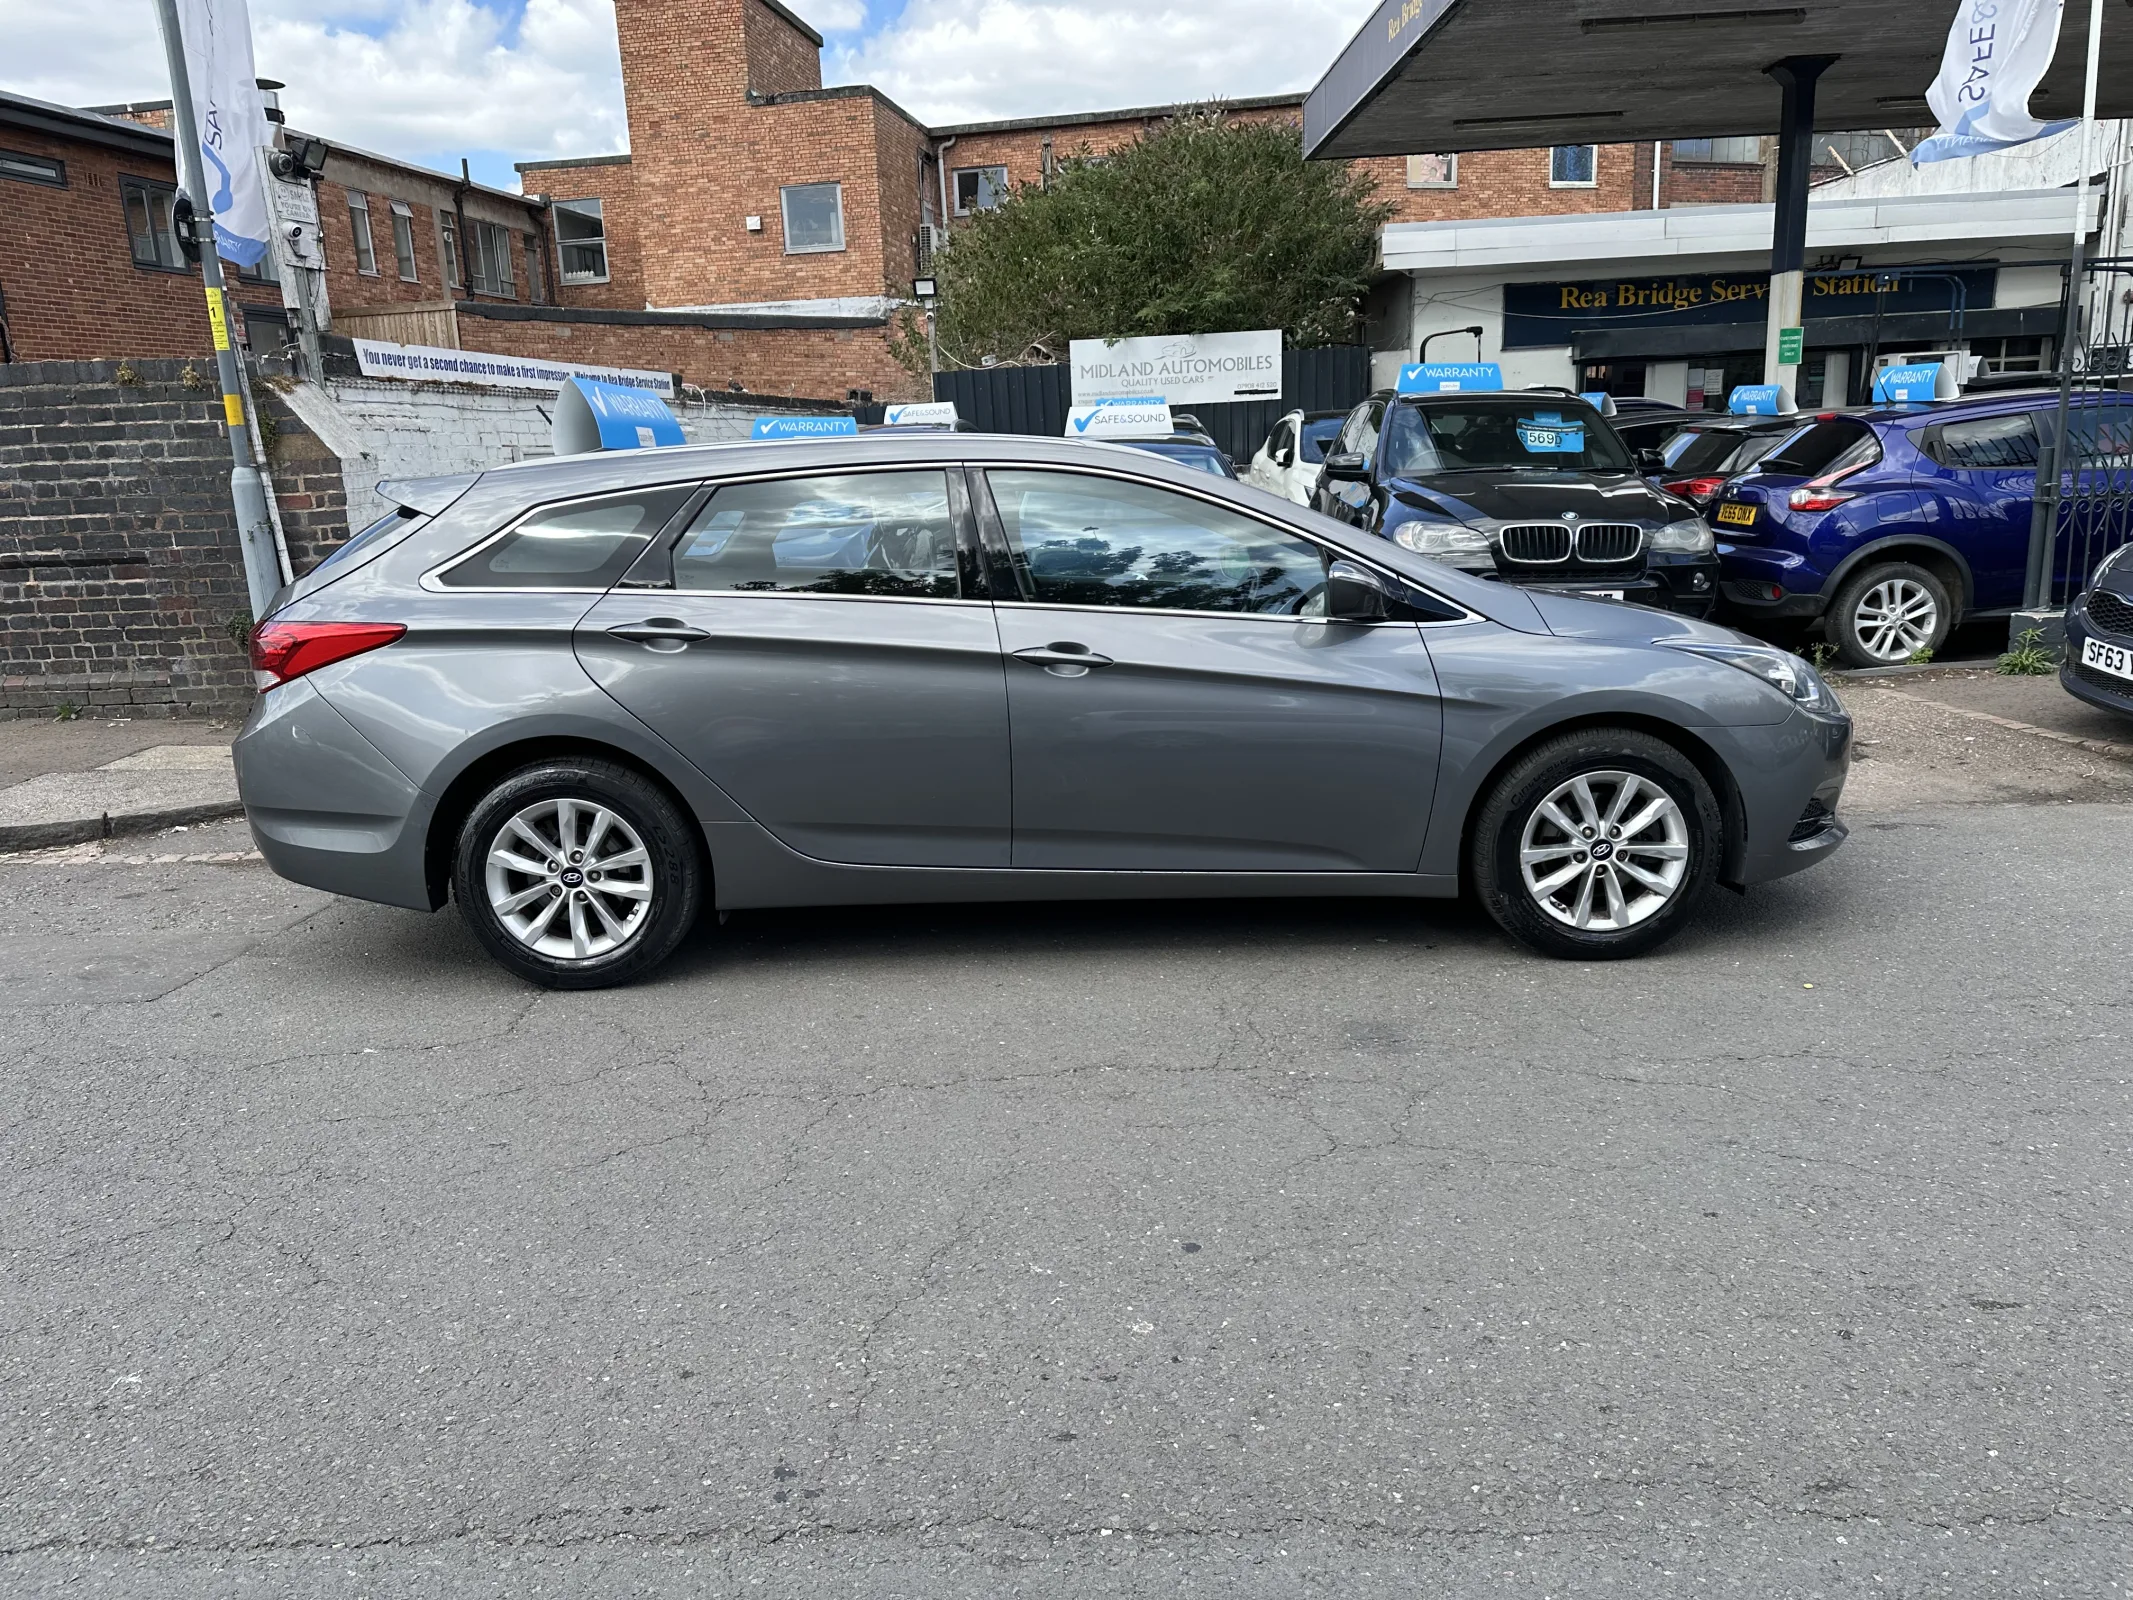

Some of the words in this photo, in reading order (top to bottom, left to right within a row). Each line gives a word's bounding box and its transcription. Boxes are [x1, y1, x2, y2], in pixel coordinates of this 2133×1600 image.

[1559, 286, 1607, 309] Rea
[1616, 282, 1702, 309] Bridge
[210, 306, 217, 318] 1
[363, 348, 381, 365] You
[381, 352, 406, 368] never
[407, 355, 422, 370] get
[423, 356, 429, 369] a
[430, 357, 459, 372] second
[460, 360, 487, 375] chance
[487, 362, 496, 375] to
[496, 363, 516, 377] make
[516, 366, 521, 377] a
[521, 364, 536, 379] first
[601, 373, 608, 384] to
[608, 373, 618, 385] Rea
[619, 375, 636, 388] Bridge
[635, 376, 654, 389] Service
[653, 378, 671, 391] Station
[1080, 361, 1154, 380] MIDLAND
[1158, 355, 1273, 375] AUTOMOBILES
[1424, 366, 1494, 378] WARRANTY
[1121, 377, 1159, 388] QUALITY
[1160, 376, 1181, 386] USED
[1182, 374, 1205, 384] CARS
[1889, 368, 1935, 385] WARRANTY
[1740, 387, 1775, 401] WARRANTY
[601, 391, 669, 421] WARRANTY
[902, 407, 950, 418] SAFE&SOUND
[1094, 413, 1166, 425] SAFE&SOUND
[778, 421, 850, 433] WARRANTY
[2089, 641, 2125, 671] SF63
